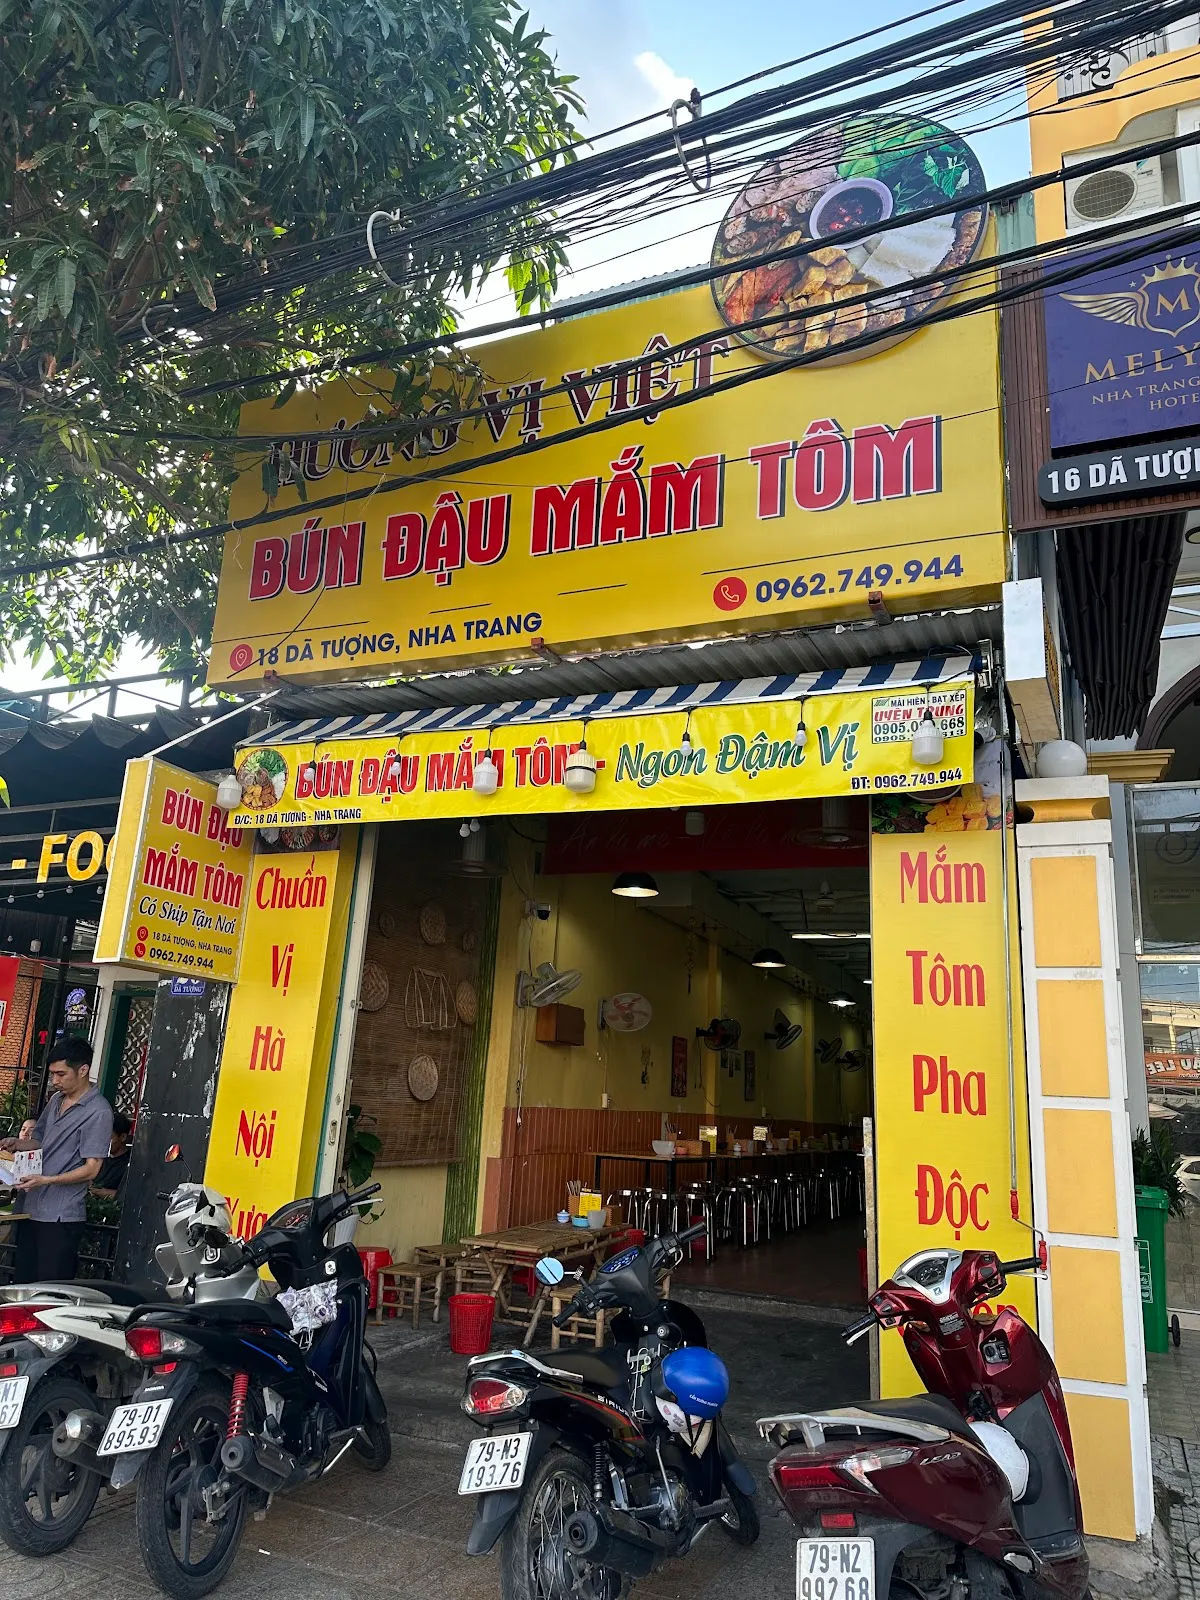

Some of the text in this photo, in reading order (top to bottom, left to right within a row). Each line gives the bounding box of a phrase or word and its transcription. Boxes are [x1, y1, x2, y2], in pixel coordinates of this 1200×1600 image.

[482, 377, 547, 445] VỊ
[561, 333, 733, 424] VIỆT
[1091, 376, 1200, 405] NHA TRANG
[1048, 467, 1081, 495] 16
[1089, 456, 1128, 488] DÃ
[249, 415, 943, 602] BÚN ĐẬU MẮM TÔM
[756, 554, 964, 604] 0962.749.944
[258, 612, 543, 667] 18 DÃ TƯỢNG, NHA TRANG
[874, 708, 912, 722] UYÊN
[907, 697, 926, 706] HIÊN
[932, 695, 947, 705] BẠT
[949, 692, 965, 703] XẾP
[874, 716, 965, 736] 0905.0.668
[294, 753, 354, 801] BÚN
[358, 749, 420, 804] ĐẬU
[615, 742, 707, 788] Ngon
[716, 731, 806, 780] Đậm
[816, 722, 860, 772] Vị
[851, 770, 963, 790] ĐT: 0962.749.944
[161, 787, 204, 836] BÚN
[234, 815, 253, 825] Đ/C:
[255, 814, 265, 824] 18
[267, 811, 279, 823] DÃ
[280, 810, 307, 825] TƯỢNG
[314, 809, 332, 821] NHA
[333, 808, 362, 820] TRANG
[36, 830, 116, 883] FO
[143, 842, 244, 908] MẮM TÔM
[900, 844, 986, 904] Mắm
[139, 896, 237, 934] Có Ship Tận Nơi
[150, 947, 214, 969] 0962.749.944
[153, 931, 161, 941] 18
[198, 941, 211, 951] NHA
[213, 944, 232, 955] TRANG
[271, 943, 295, 997] Vị
[905, 950, 986, 1006] Tôm
[249, 1025, 286, 1072] Hà
[912, 1054, 987, 1116] Pha
[235, 1109, 278, 1167] Nội
[914, 1164, 990, 1240] Độc
[117, 1404, 162, 1428] 79-D1
[103, 1424, 160, 1452] 895.93
[479, 1437, 521, 1464] 79-N3
[466, 1461, 522, 1489] 193.76
[919, 1451, 962, 1466] LEAD
[808, 1543, 861, 1574] 79-N2
[801, 1576, 869, 1600] 99268
